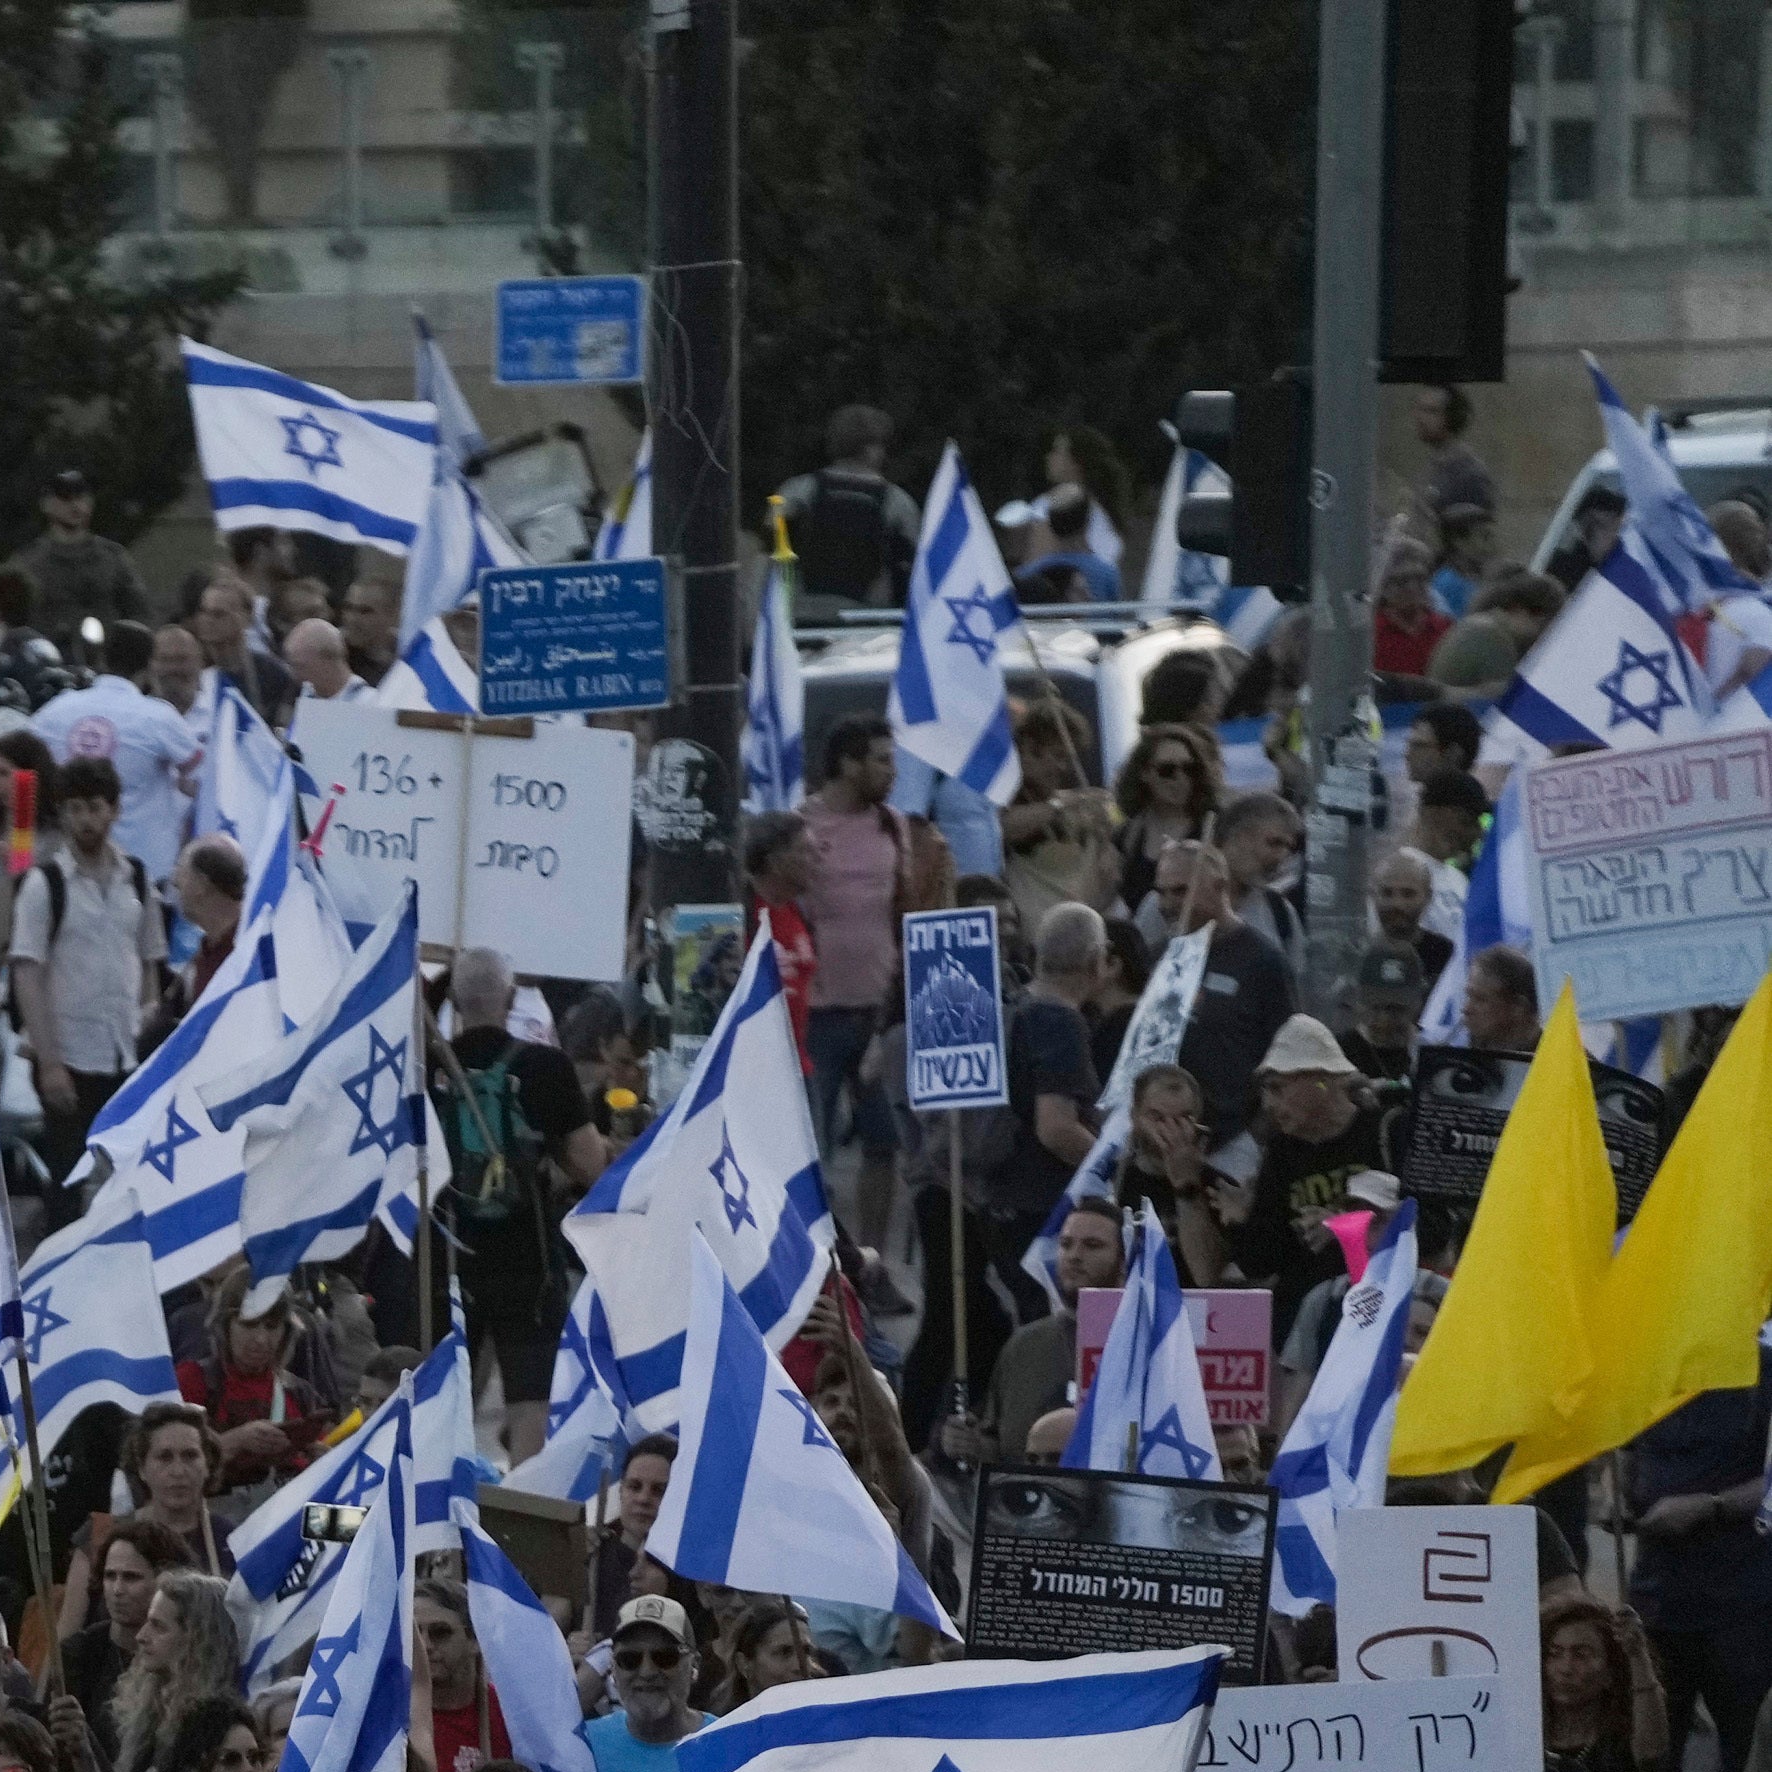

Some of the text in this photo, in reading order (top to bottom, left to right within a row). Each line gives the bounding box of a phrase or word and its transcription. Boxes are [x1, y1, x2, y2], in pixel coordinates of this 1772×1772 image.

[489, 579, 547, 614] רבין
[578, 673, 634, 699] RABIN
[351, 751, 418, 796] 136
[491, 773, 569, 812] 1500
[910, 921, 991, 952] בחירות
[1212, 1401, 1262, 1421] אות
[1031, 1566, 1224, 1609] 1500 חללי המחדל
